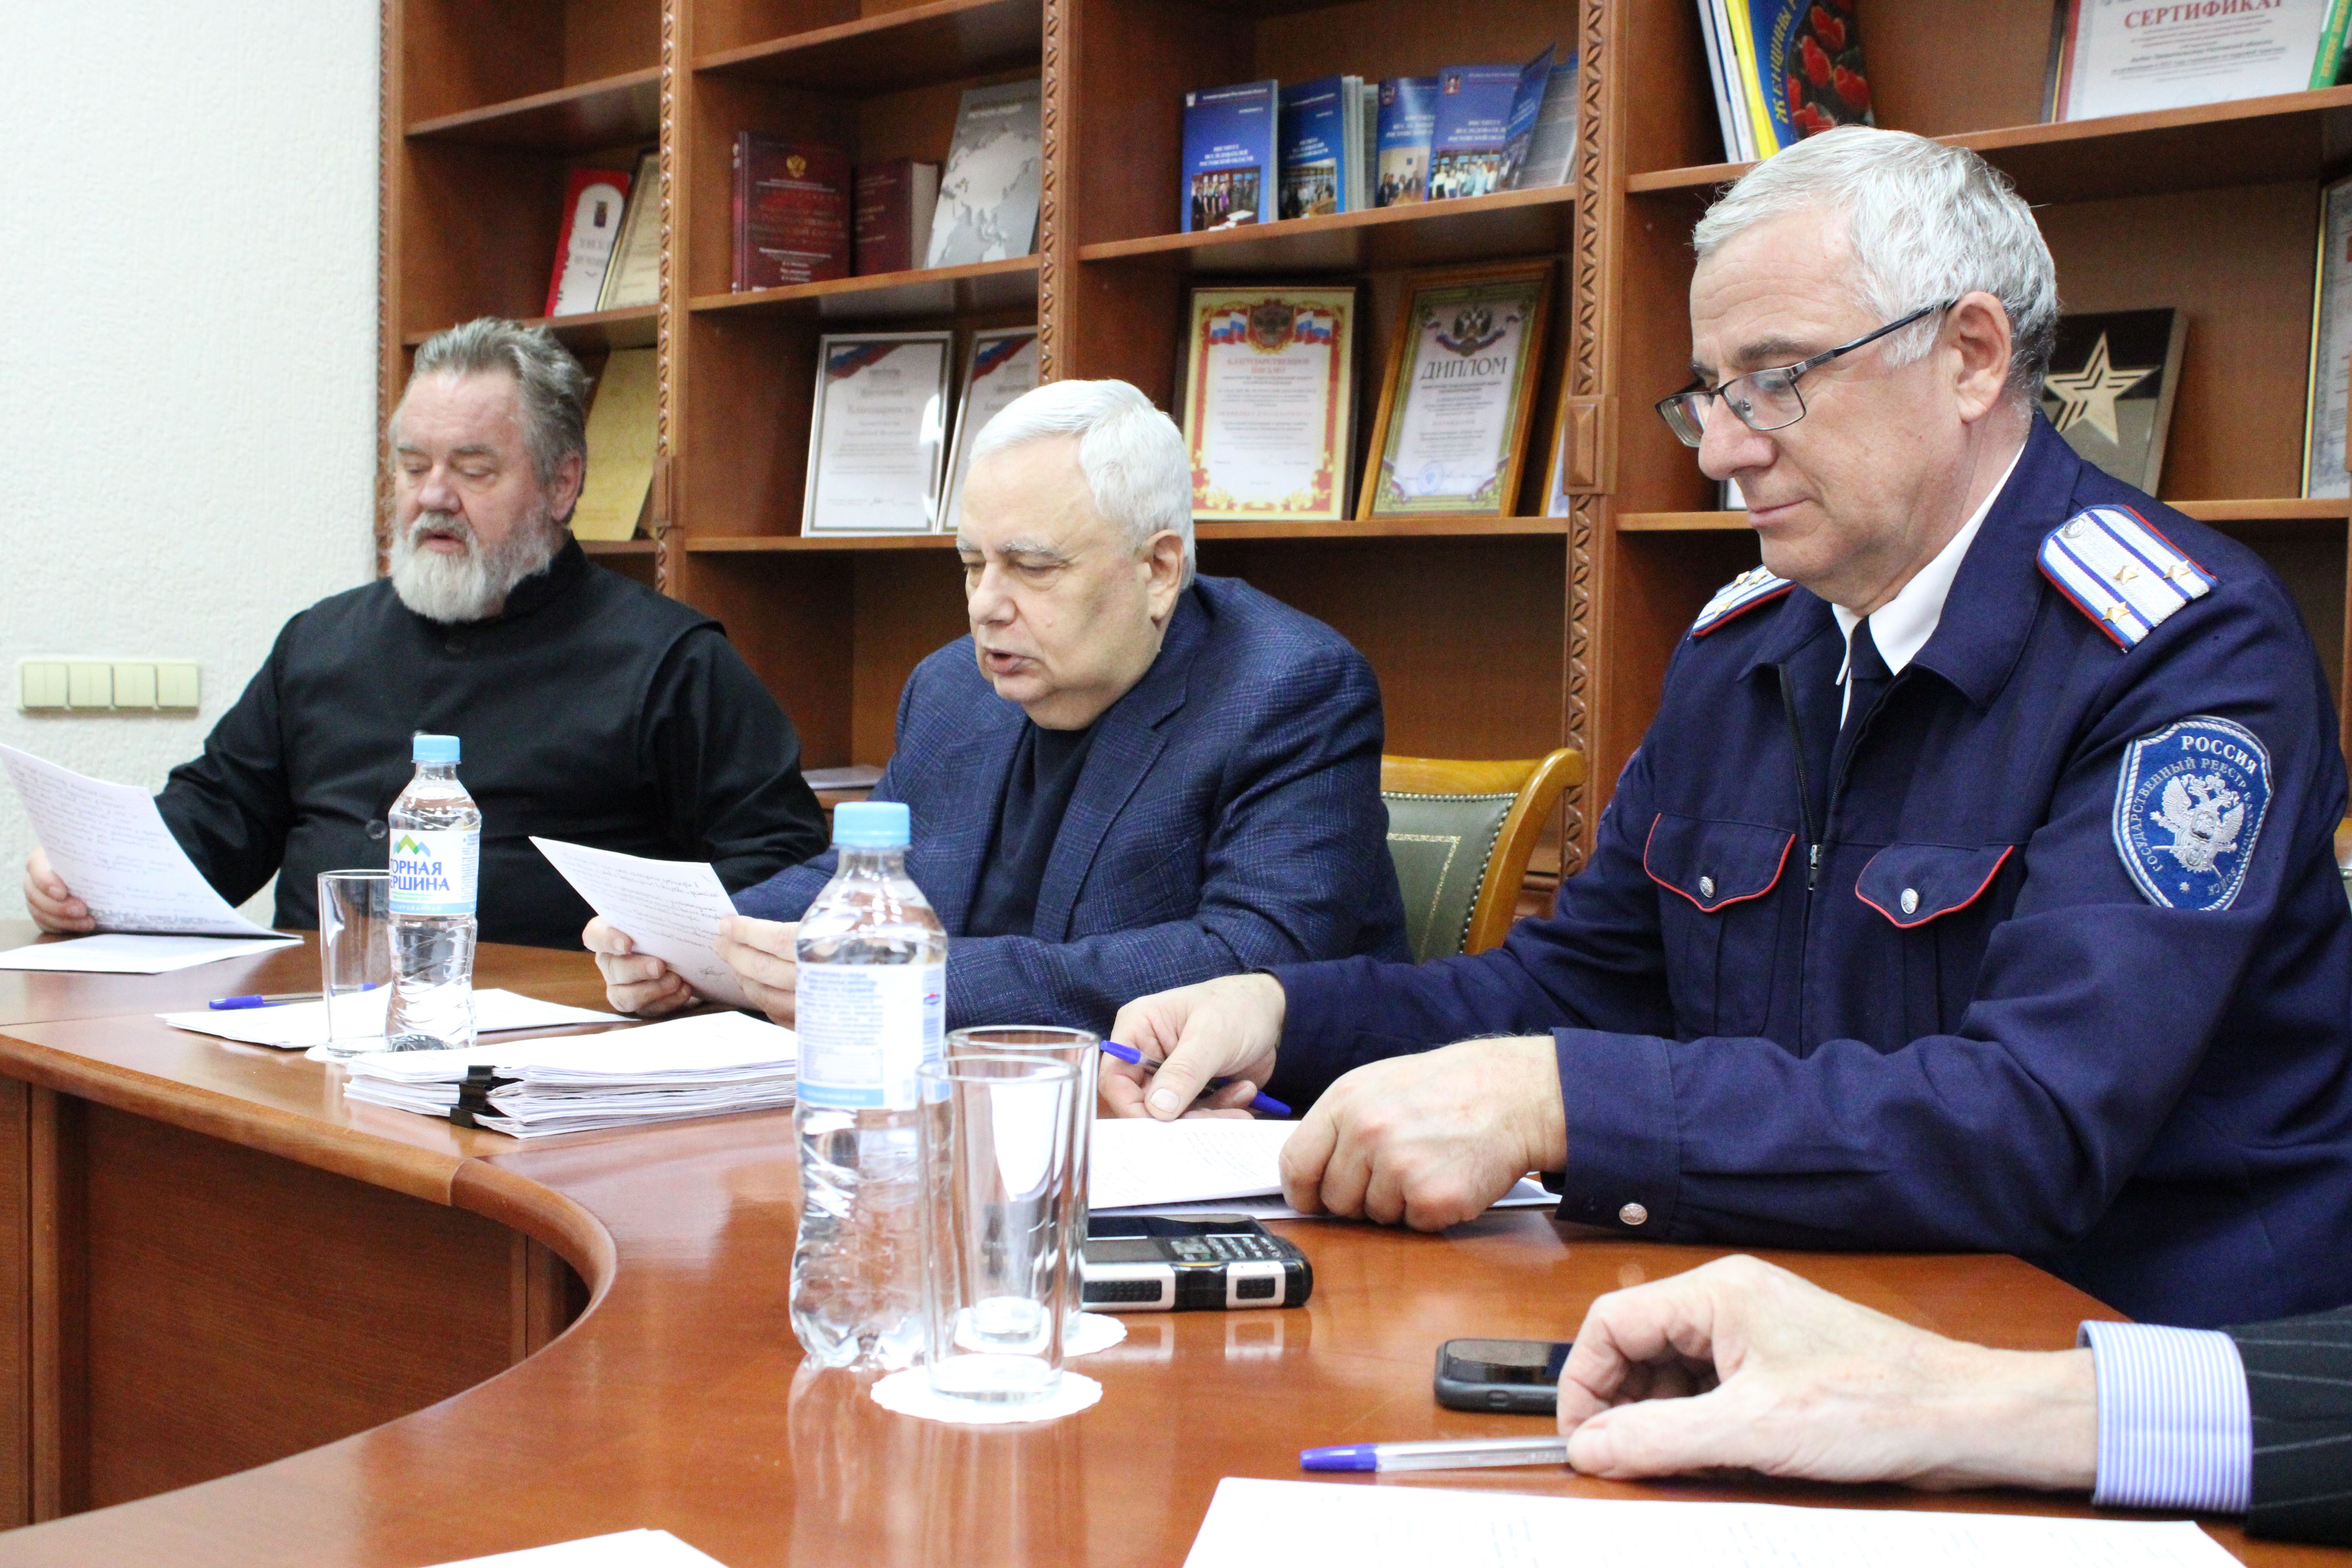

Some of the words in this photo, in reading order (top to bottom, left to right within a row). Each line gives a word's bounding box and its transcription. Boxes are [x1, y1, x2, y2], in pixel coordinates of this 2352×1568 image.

[1420, 356, 1507, 380] ДИПЛОМ
[2181, 735, 2257, 774] РОССИЯ
[2130, 757, 2196, 872] ГОСУДАРСТВЕННЫЙ
[2201, 758, 2247, 788] РЕЕСТР
